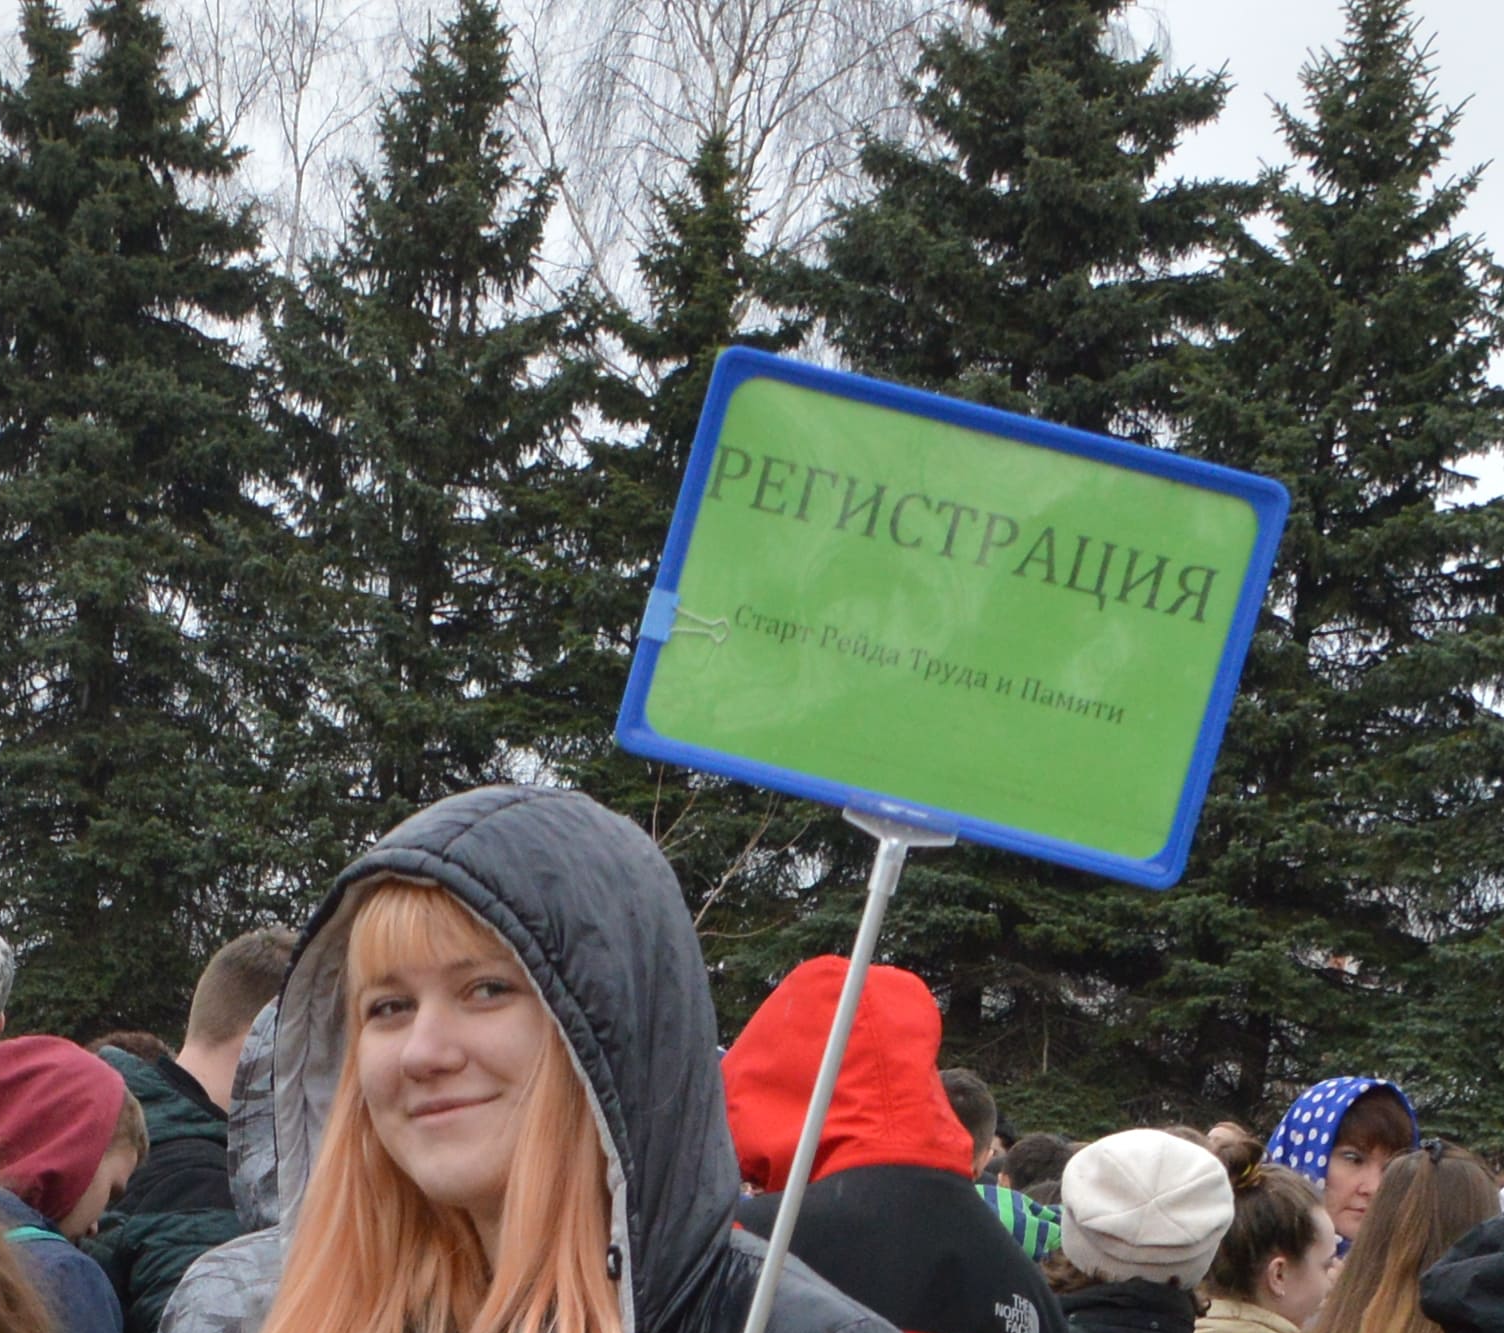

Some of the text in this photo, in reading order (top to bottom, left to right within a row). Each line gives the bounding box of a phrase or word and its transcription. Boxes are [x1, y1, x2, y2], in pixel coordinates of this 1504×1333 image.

[706, 445, 1219, 624] РЕГИСТРАЦИЯ
[734, 604, 1125, 725] Старт Рейда Труда и Памяти
[994, 1302, 1031, 1326] NORTH
[1012, 1293, 1030, 1312] THE
